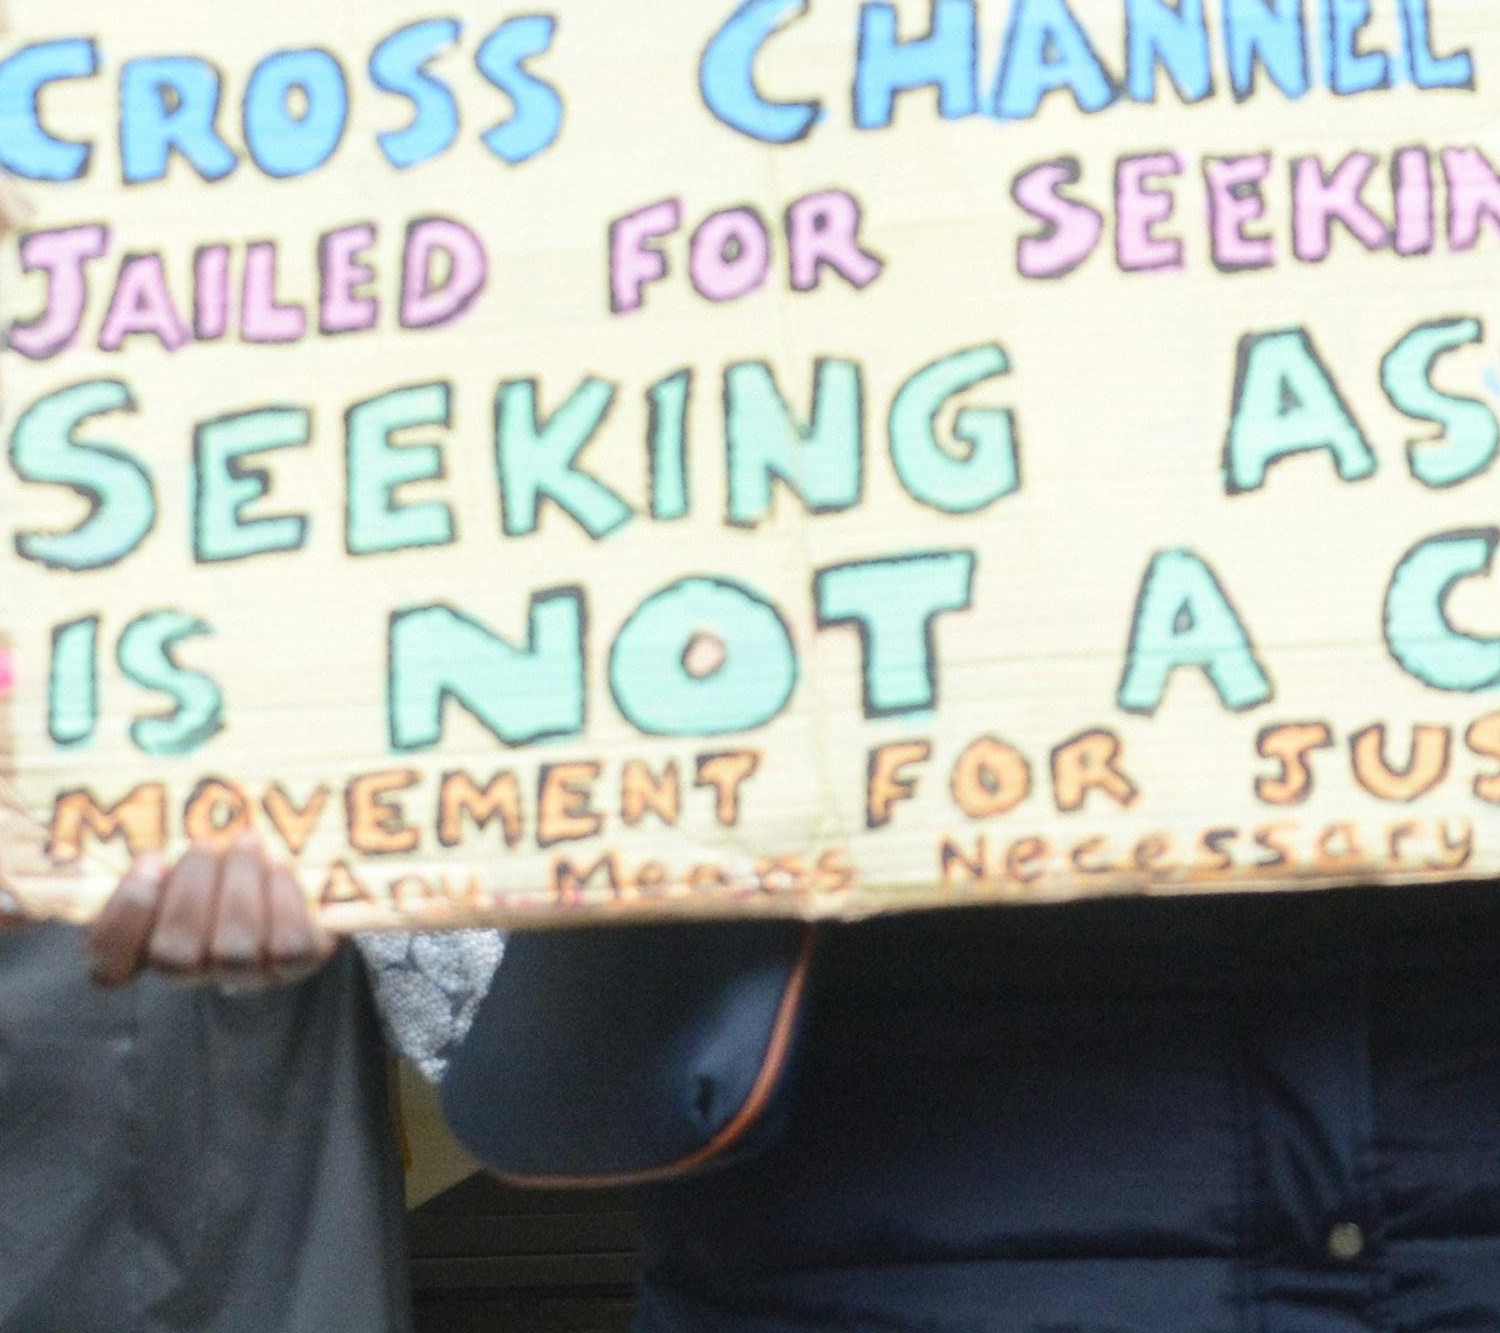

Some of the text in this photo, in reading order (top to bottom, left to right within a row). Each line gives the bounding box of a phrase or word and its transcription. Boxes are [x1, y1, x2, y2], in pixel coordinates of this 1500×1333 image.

[7, 214, 491, 360] JAILED
[610, 186, 885, 313] FOR
[7, 343, 1023, 573] SEEKING
[46, 609, 226, 758] IS
[384, 548, 978, 755] NOT
[1116, 546, 1273, 714] A
[46, 749, 764, 862] MOVEMENT
[864, 730, 1142, 829] FOR
